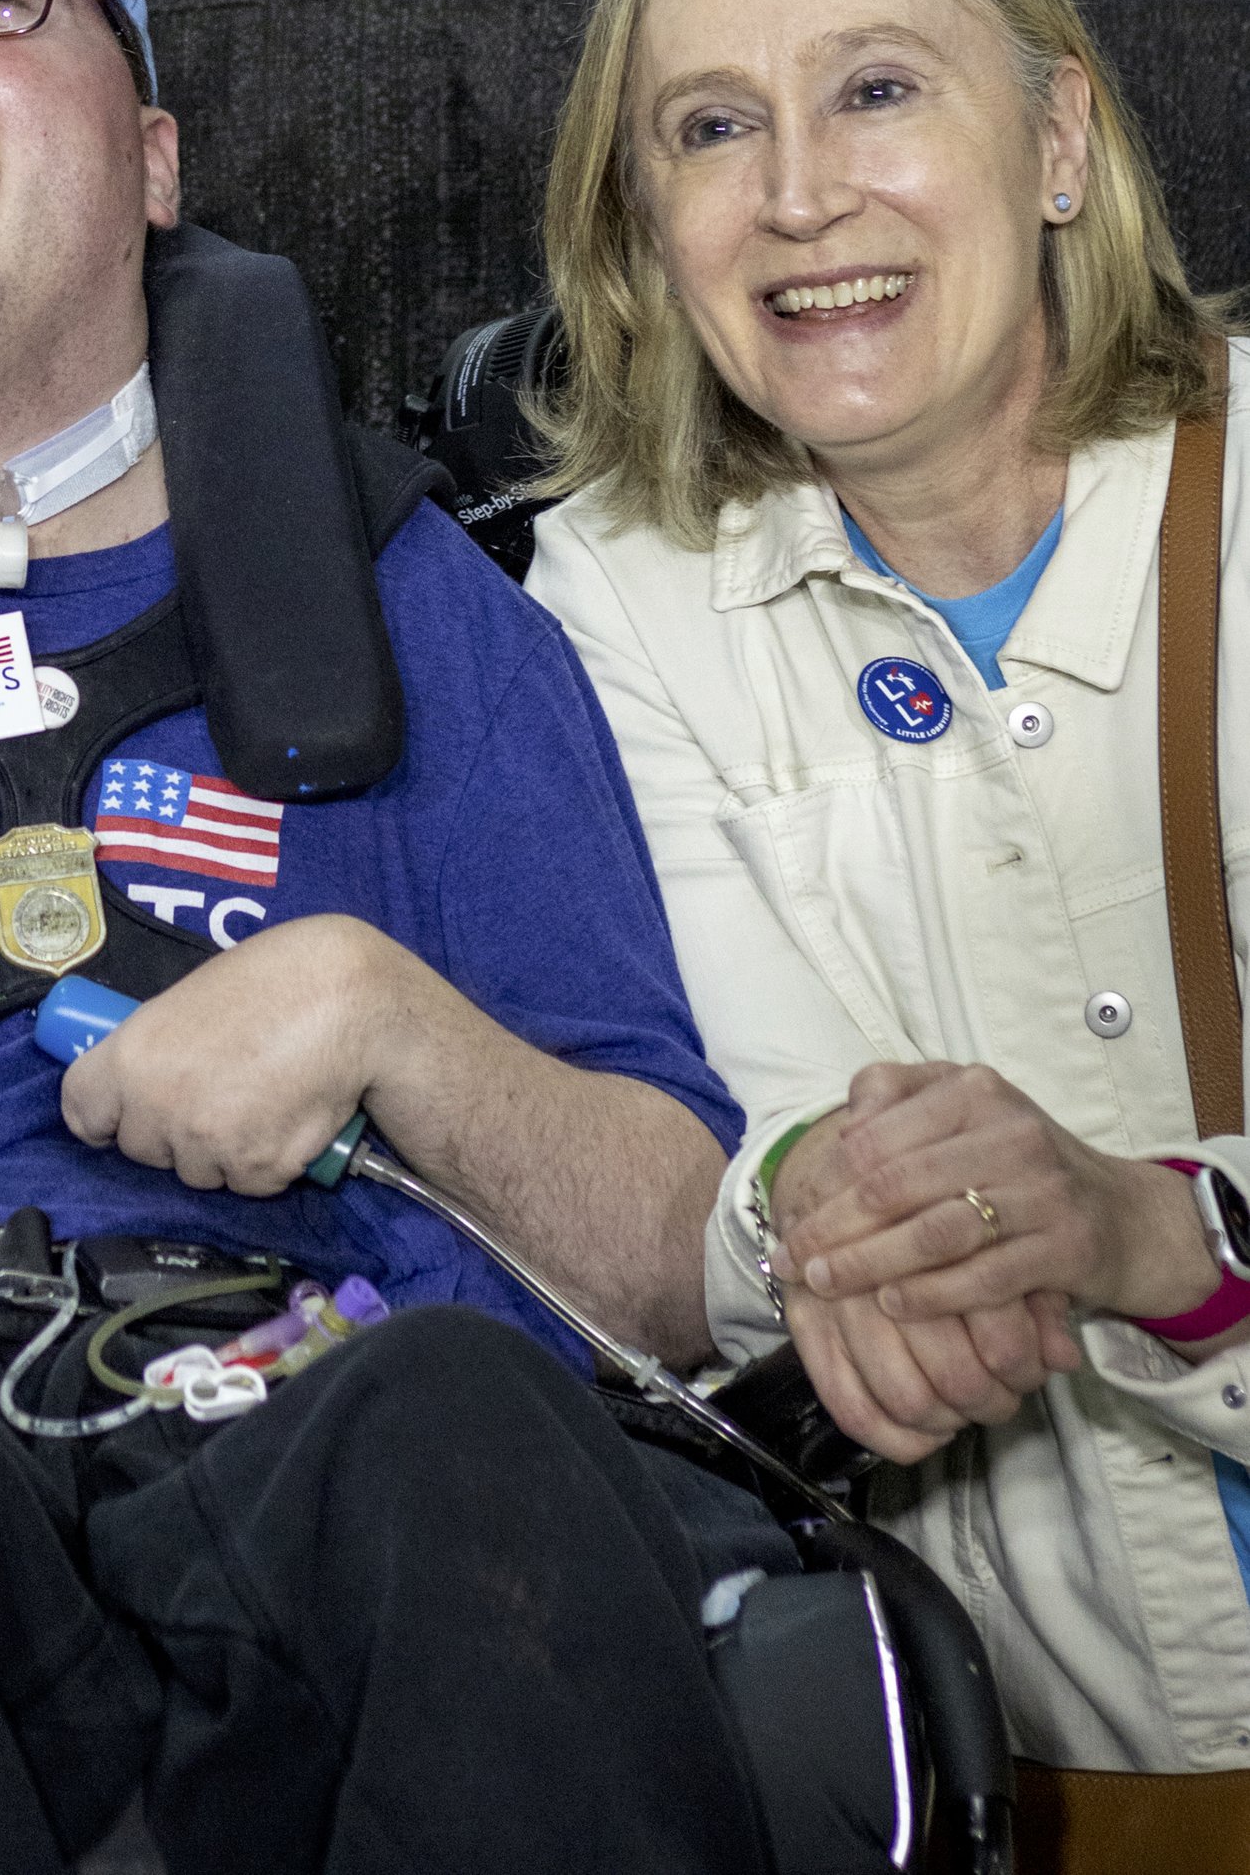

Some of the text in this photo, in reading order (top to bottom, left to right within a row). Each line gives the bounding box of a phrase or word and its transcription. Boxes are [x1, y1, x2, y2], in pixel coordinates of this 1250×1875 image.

[43, 698, 70, 719] RIGHTS
[51, 688, 75, 708] RIGHTS
[896, 703, 951, 739] LITTLE LOBBYISTS
